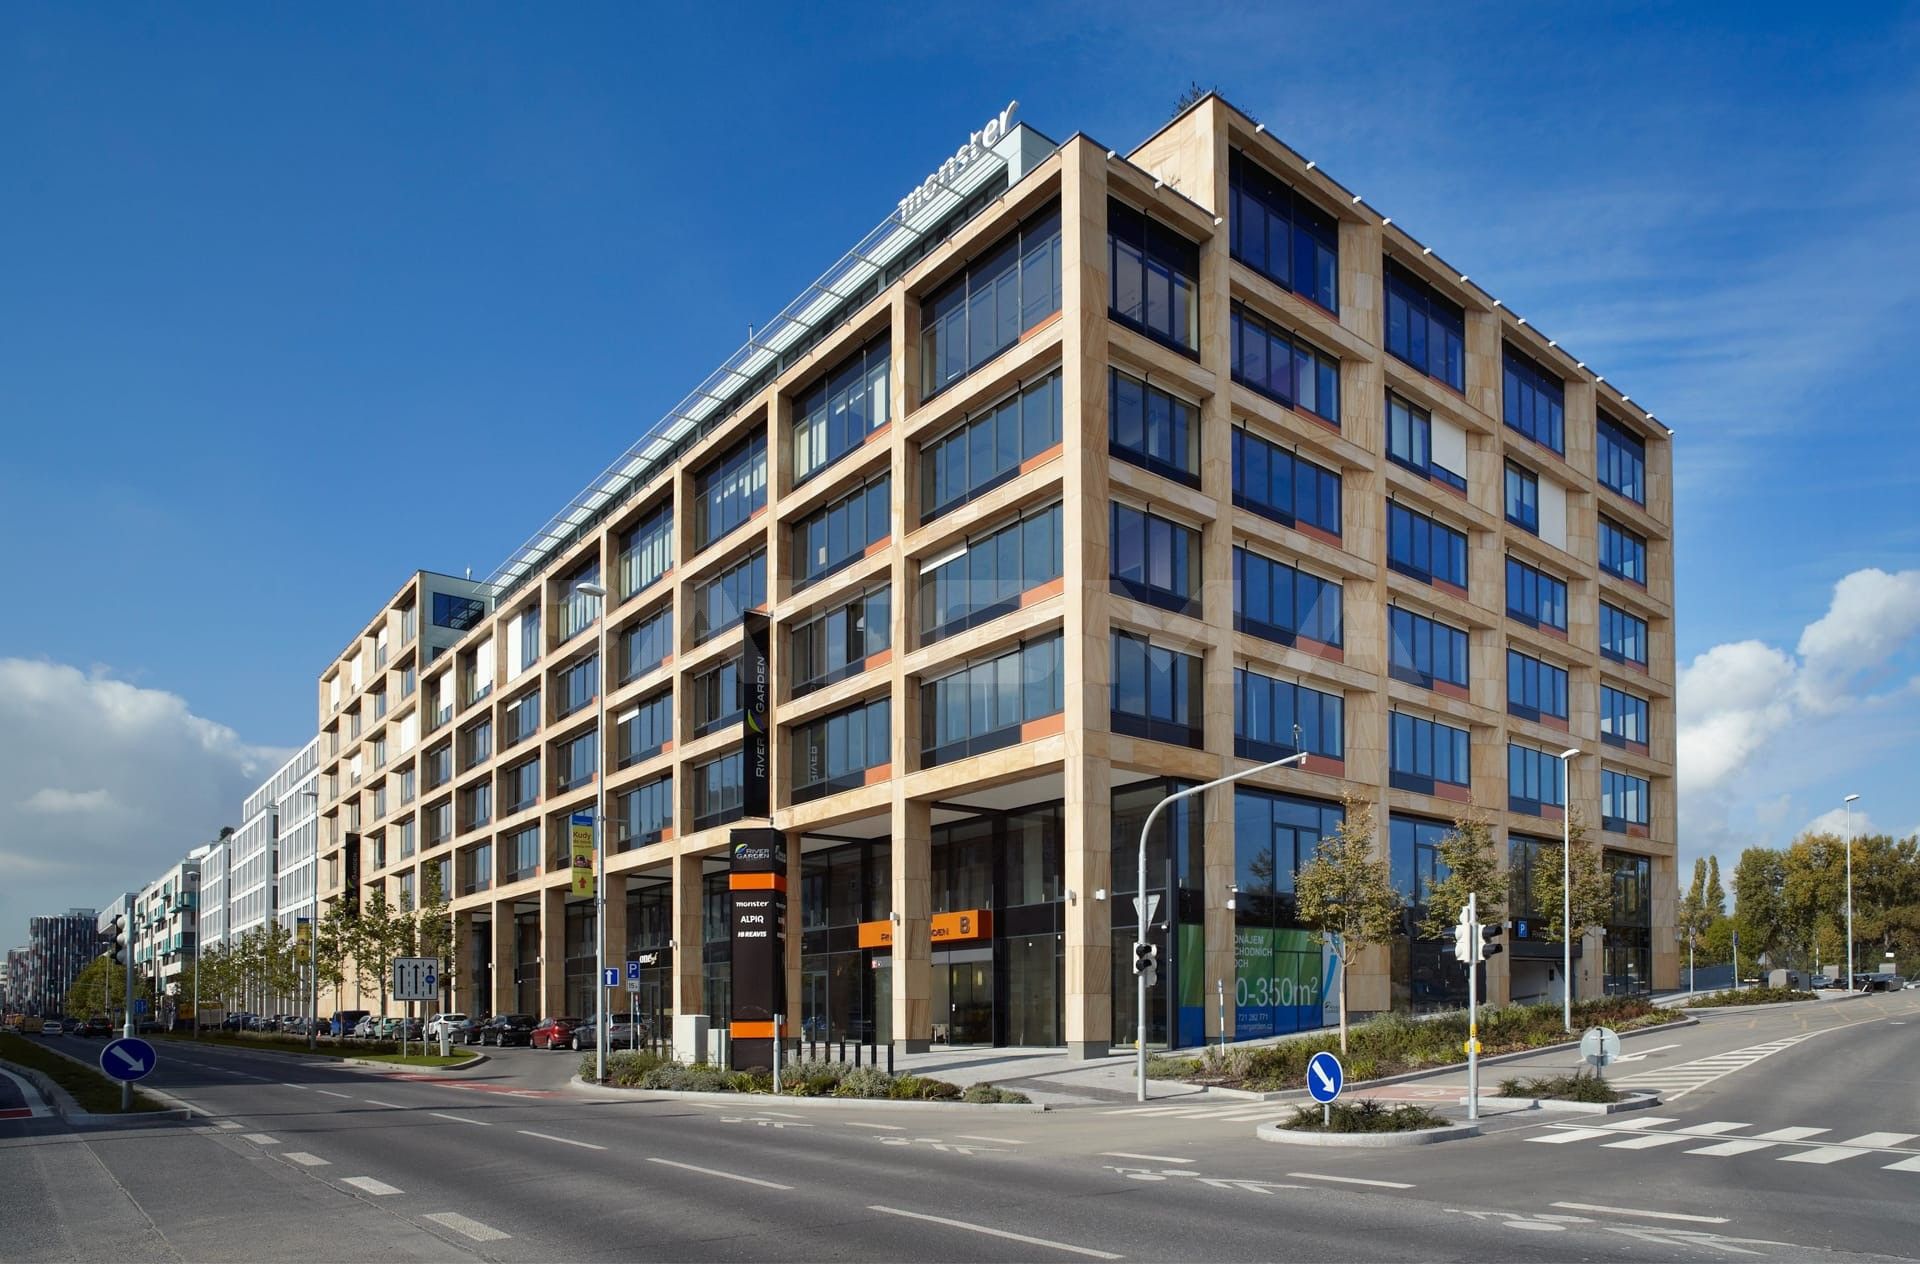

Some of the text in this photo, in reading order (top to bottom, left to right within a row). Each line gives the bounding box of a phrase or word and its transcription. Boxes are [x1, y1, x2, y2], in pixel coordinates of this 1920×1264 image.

[898, 100, 1019, 222] monster
[755, 656, 765, 778] RIVER GARDEN
[573, 831, 592, 840] Kudy
[740, 915, 764, 924] ALPIQ
[629, 963, 638, 975] P
